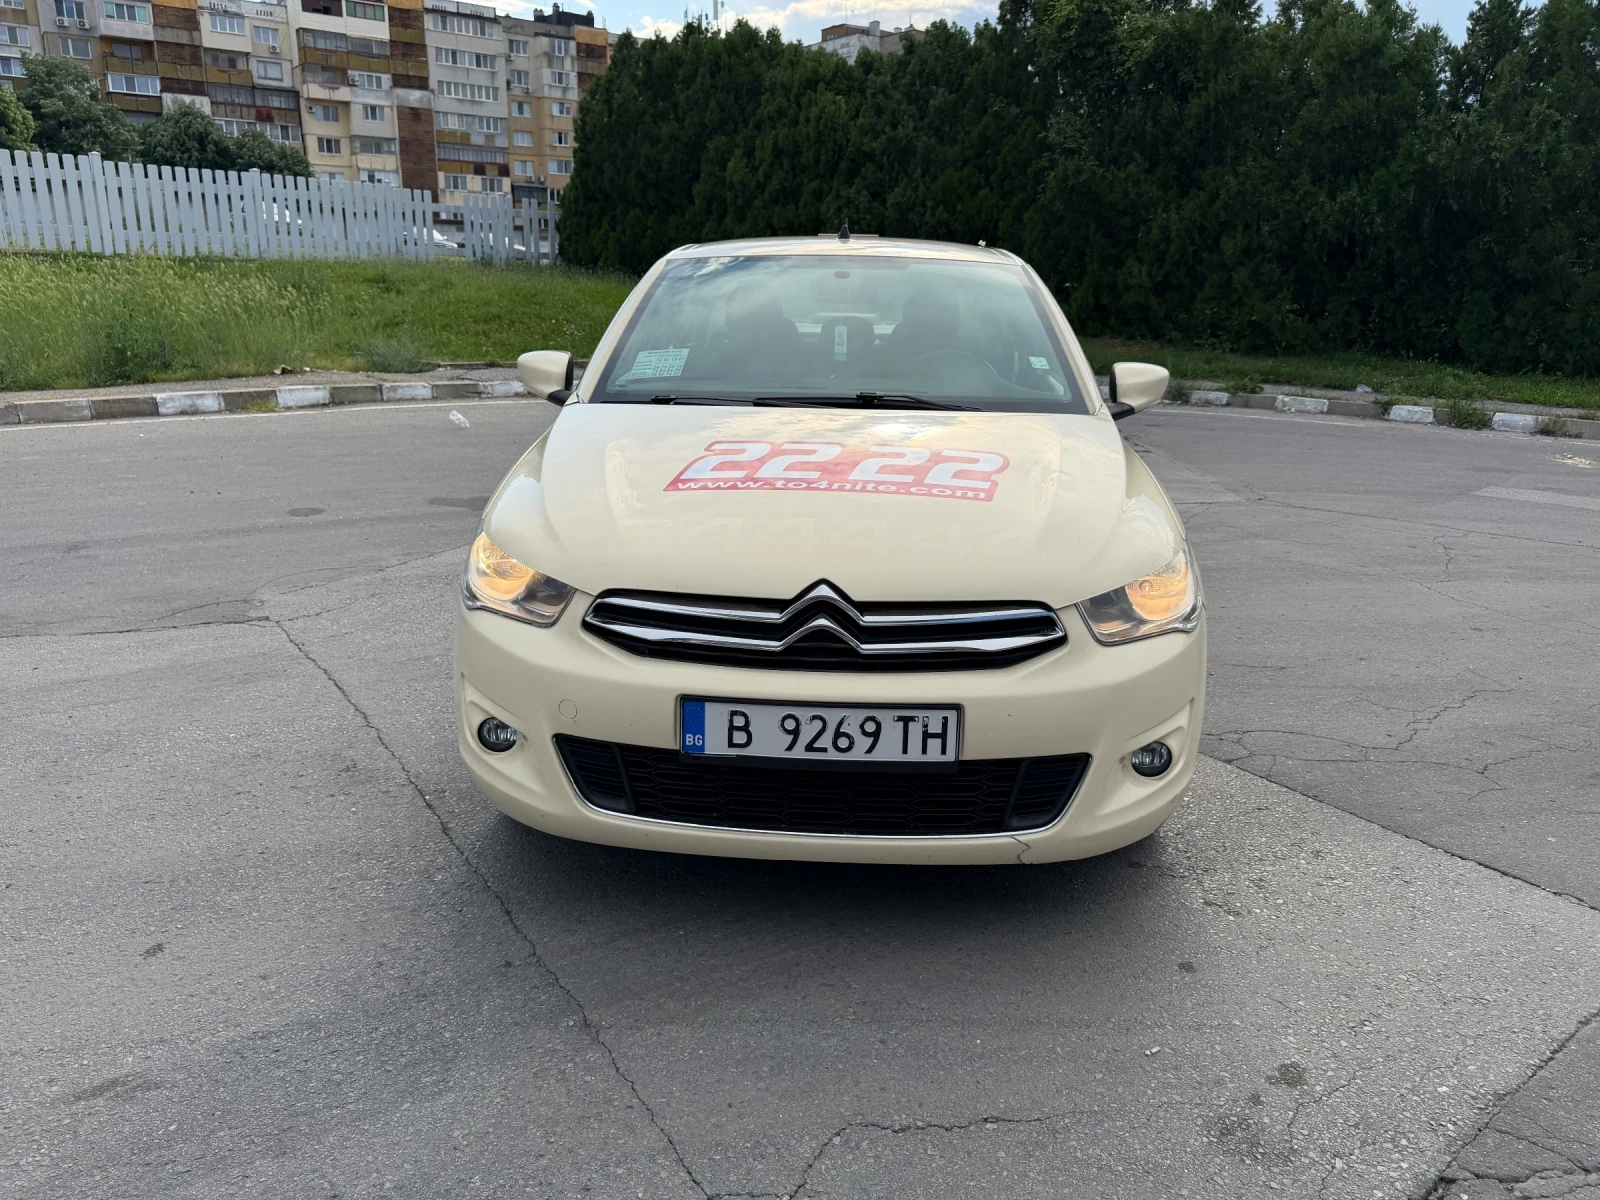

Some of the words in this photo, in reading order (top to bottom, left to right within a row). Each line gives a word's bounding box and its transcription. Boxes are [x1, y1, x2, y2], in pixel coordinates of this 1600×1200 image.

[679, 442, 842, 479] 22
[847, 445, 1004, 489] 22
[677, 479, 987, 499] www.to4nite.com
[685, 733, 703, 746] BG
[727, 709, 753, 749] B
[778, 712, 882, 755] 9269
[893, 715, 949, 755] TH
